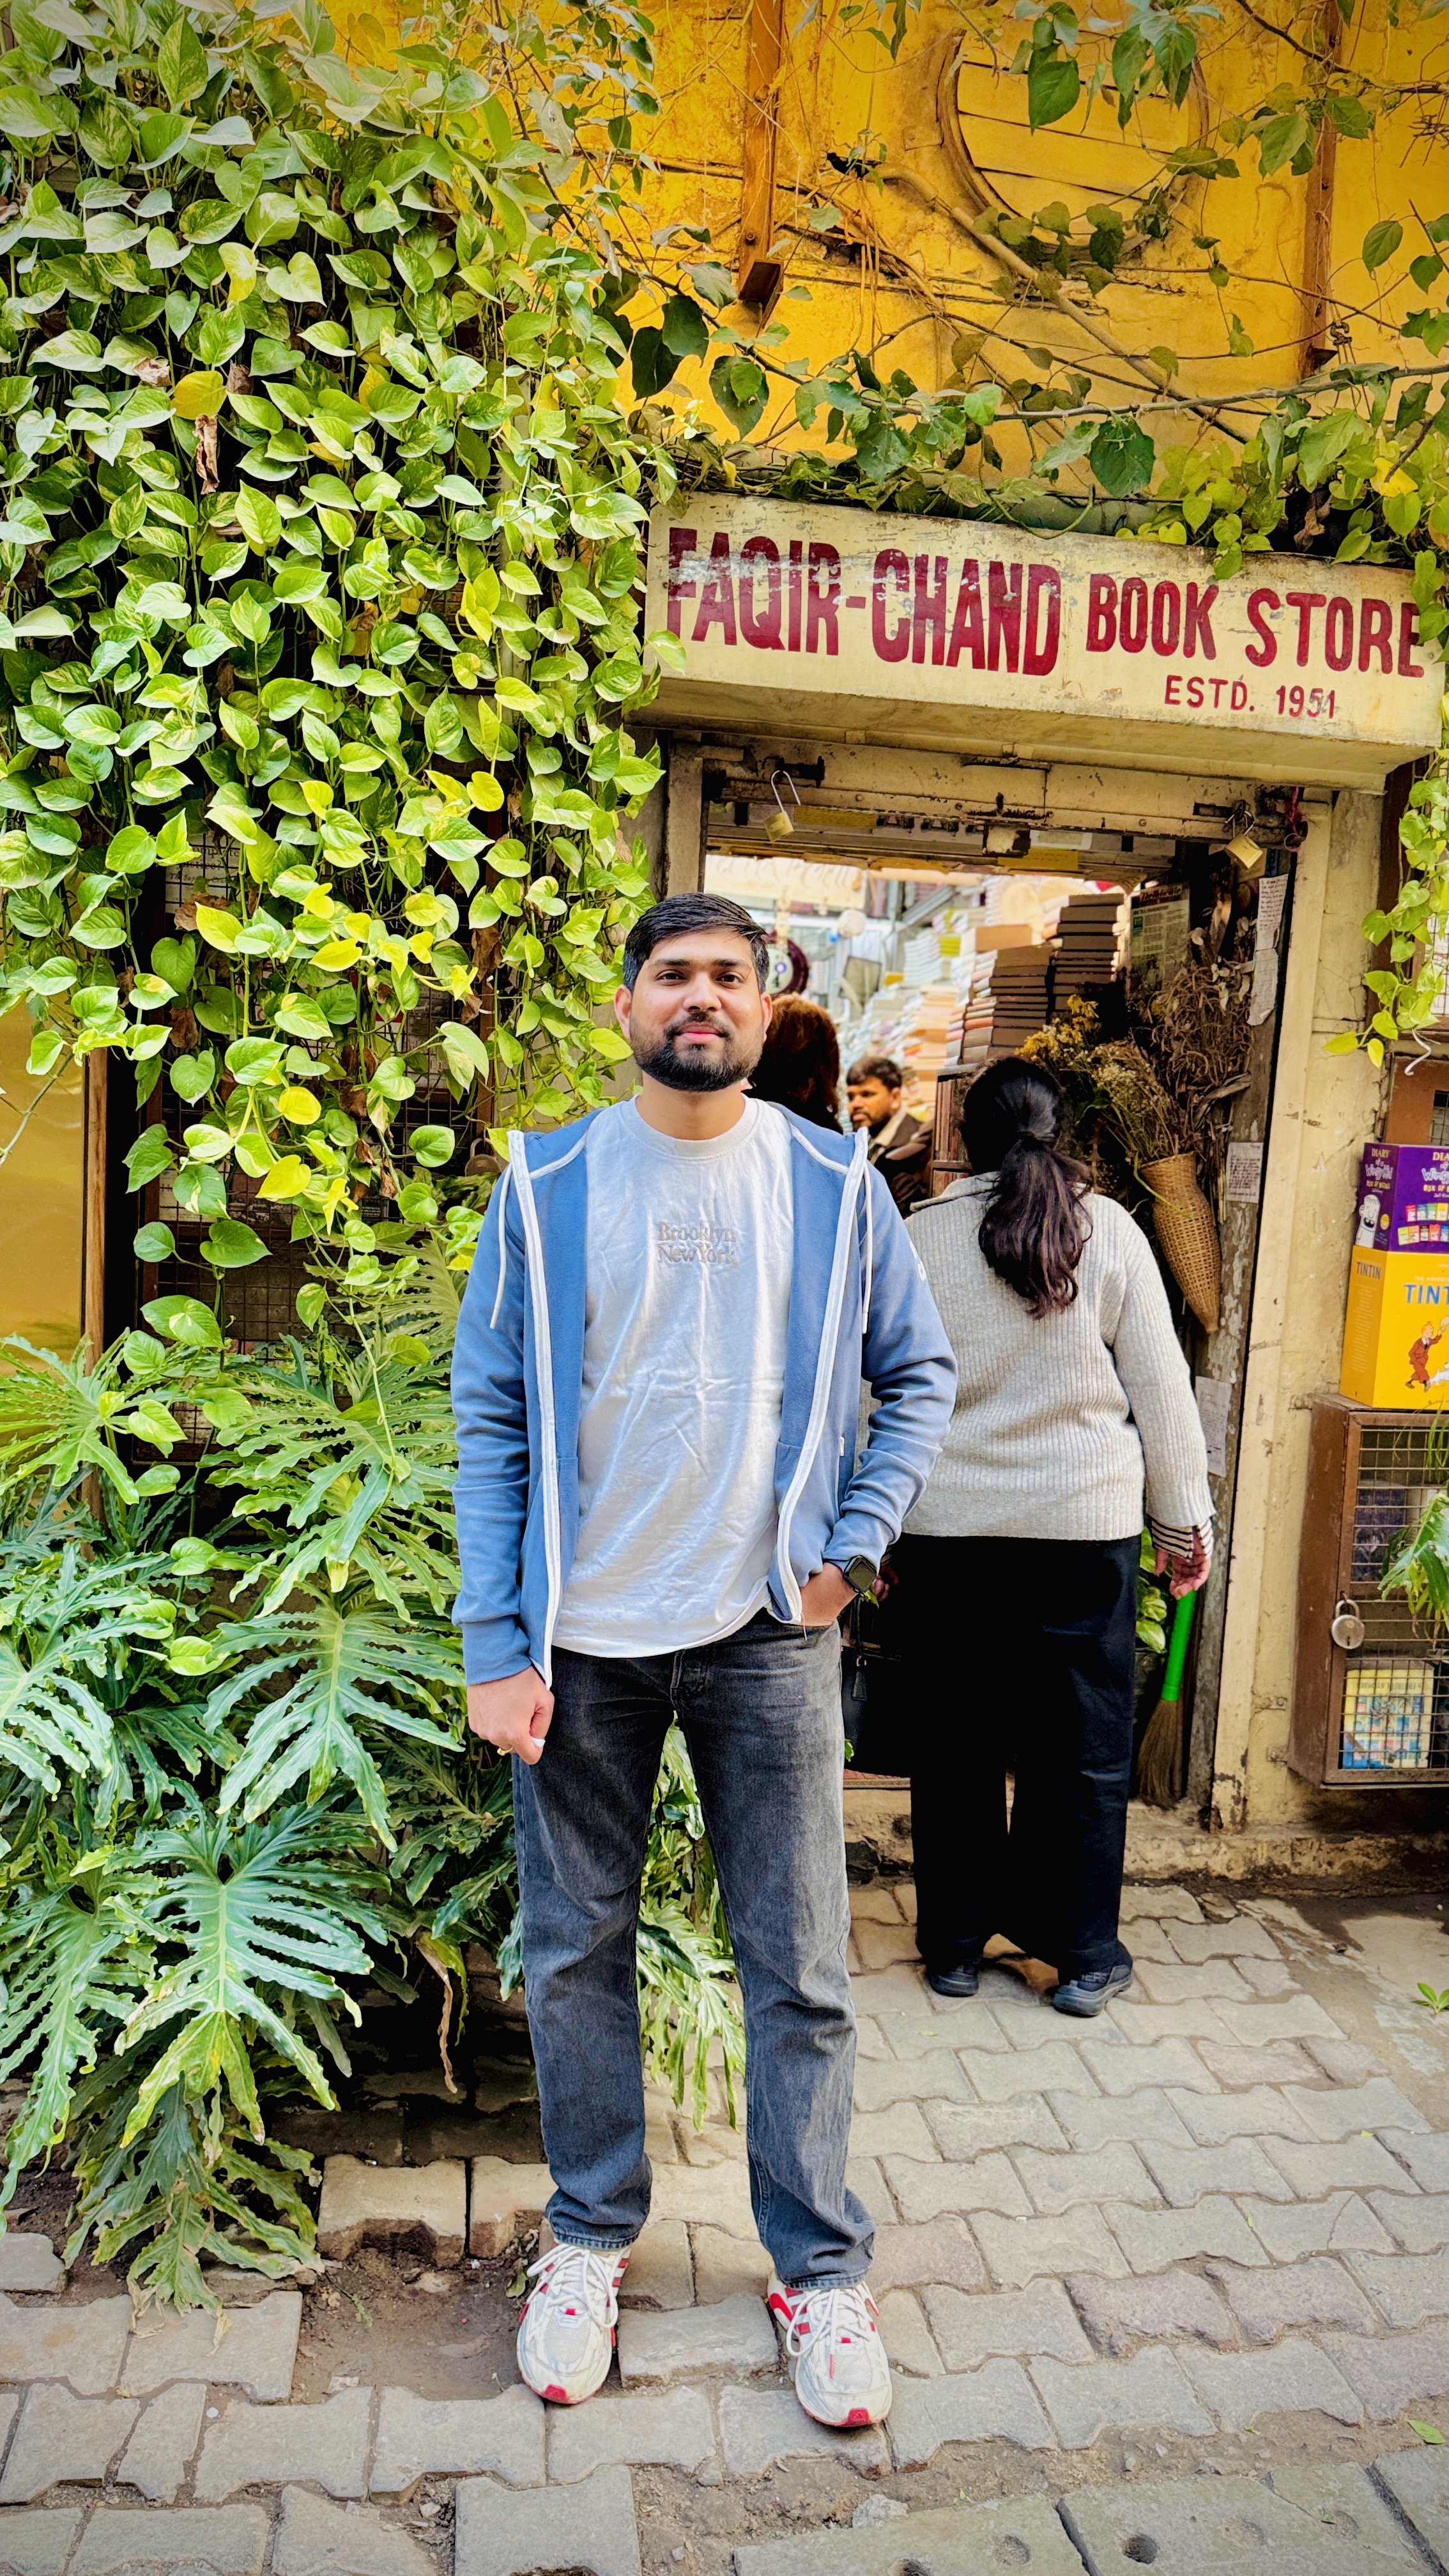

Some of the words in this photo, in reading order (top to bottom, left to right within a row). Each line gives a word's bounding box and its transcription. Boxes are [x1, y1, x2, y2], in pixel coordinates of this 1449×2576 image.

[667, 526, 1061, 676] FAQIR-CHAND
[1086, 574, 1219, 660] BOOK
[1245, 588, 1425, 678] STORE
[1165, 674, 1255, 712] ESTD.
[1277, 685, 1336, 719] 1951
[1371, 1148, 1390, 1158] DIARY
[1422, 1168, 1449, 1185] Wimp
[658, 1220, 736, 1246] Brooklyn
[657, 1243, 696, 1262] New
[696, 1241, 737, 1264] York
[1356, 1261, 1381, 1280] TINTIN
